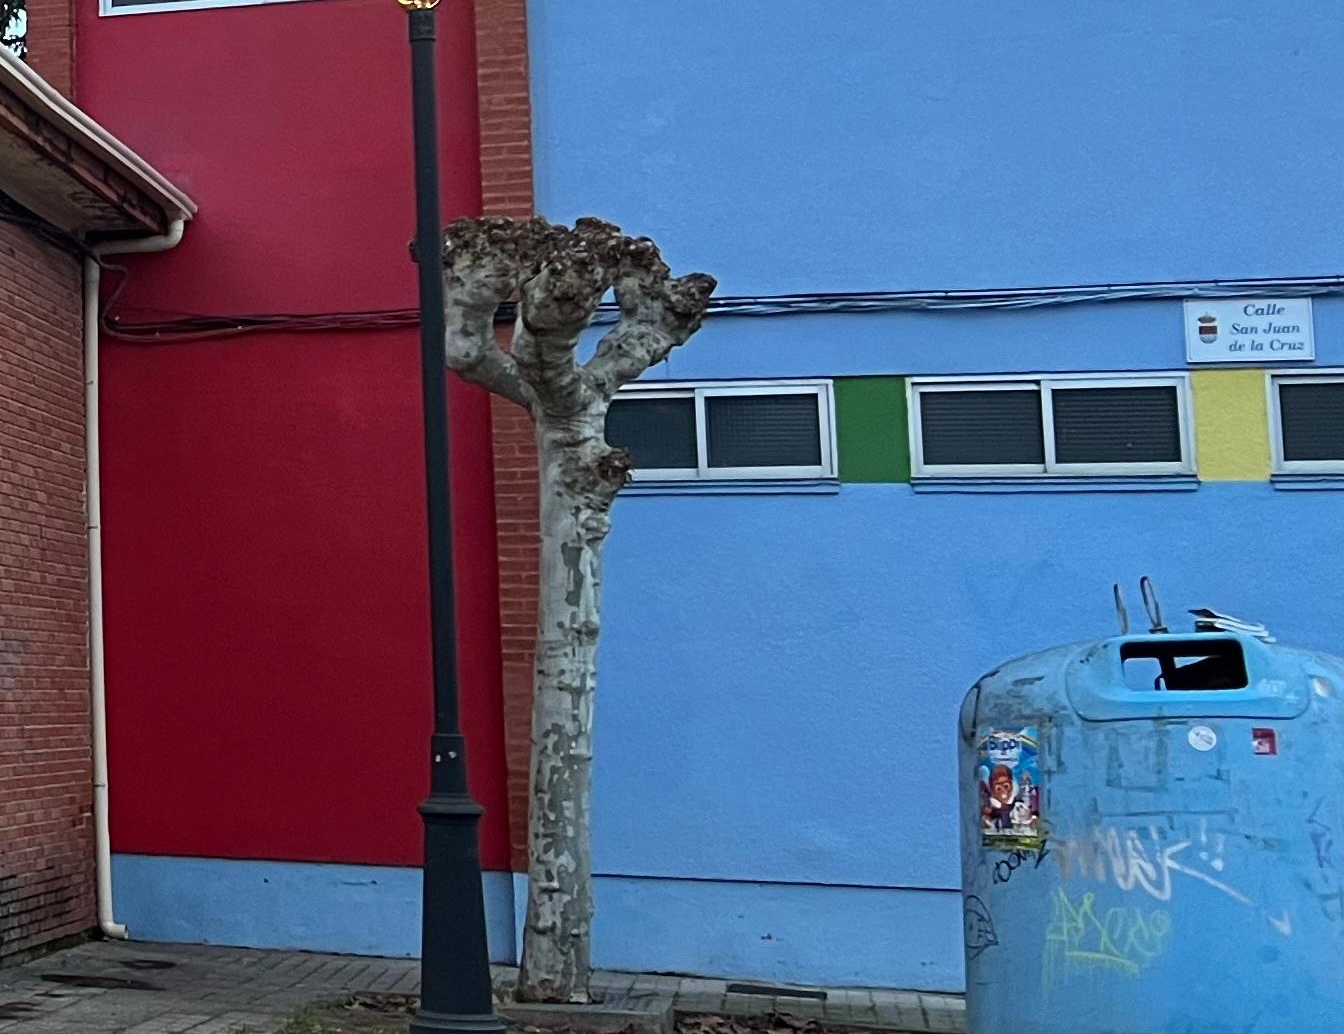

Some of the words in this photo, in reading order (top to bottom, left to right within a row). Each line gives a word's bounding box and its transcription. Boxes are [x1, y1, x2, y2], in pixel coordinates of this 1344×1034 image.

[1243, 303, 1286, 317] Calle
[1229, 322, 1259, 336] San
[1262, 322, 1301, 335] Juan
[1228, 339, 1246, 352] de
[1250, 339, 1264, 352] la
[1269, 338, 1305, 351] Cruz
